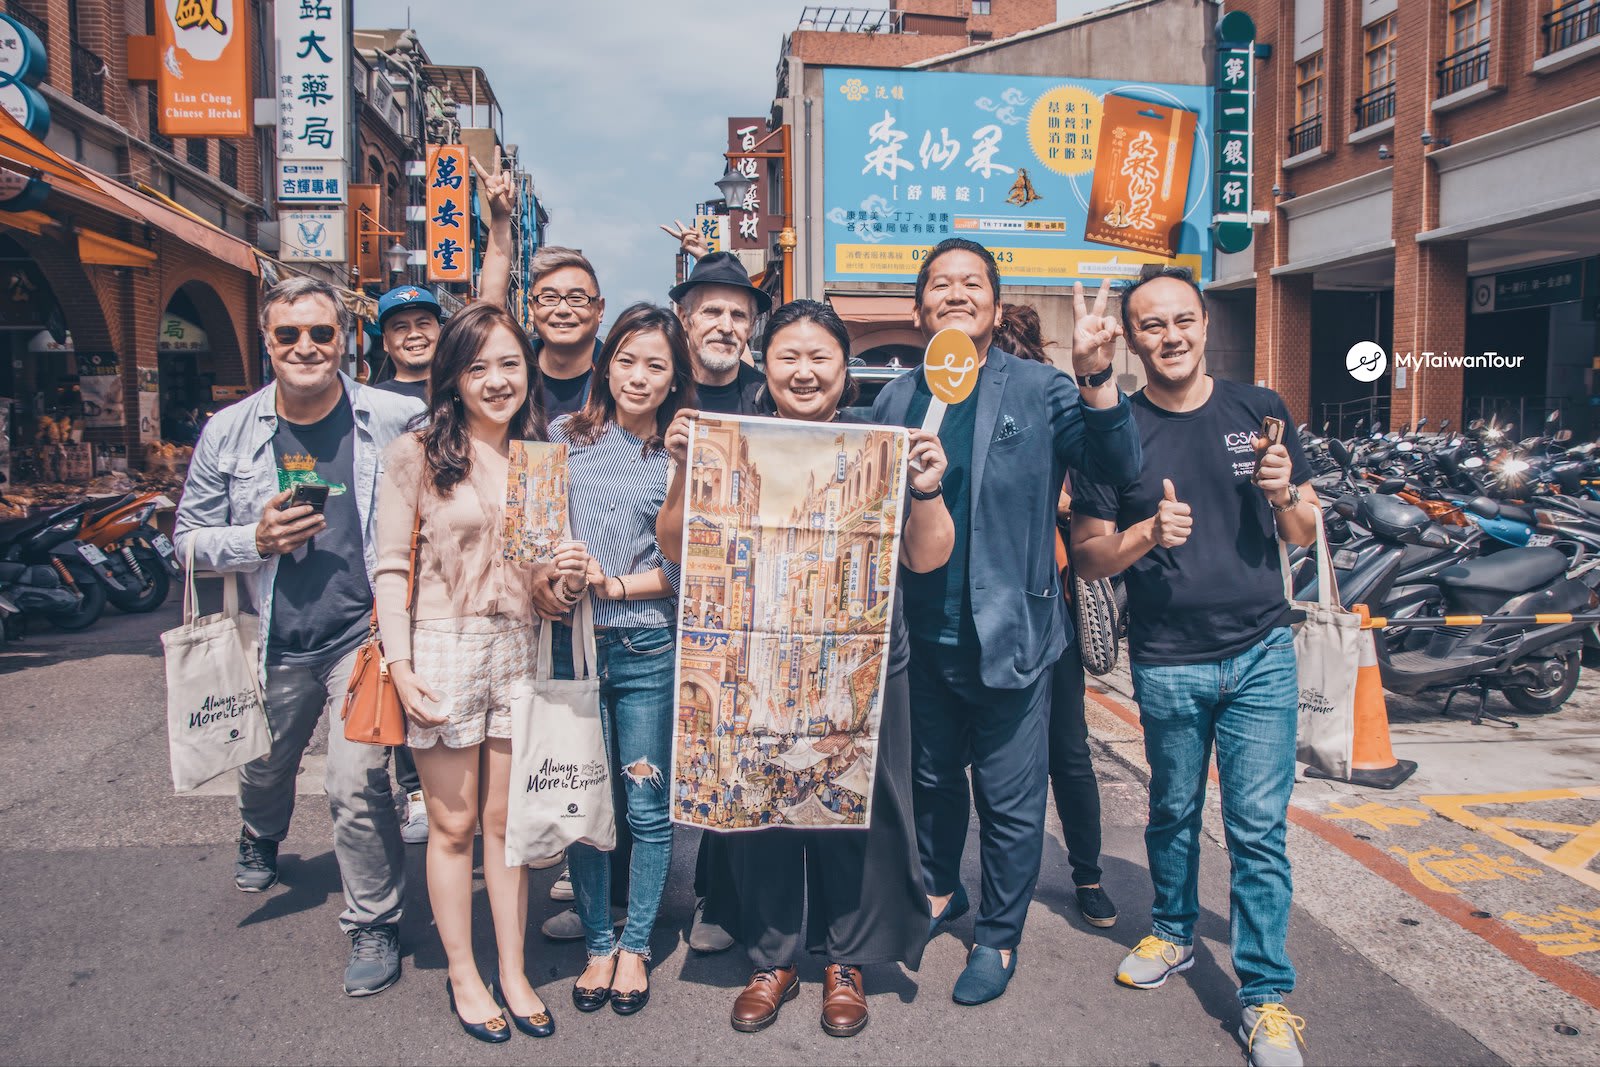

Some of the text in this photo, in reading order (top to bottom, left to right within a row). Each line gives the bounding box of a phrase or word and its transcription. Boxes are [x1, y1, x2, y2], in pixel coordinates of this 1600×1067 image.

[174, 92, 232, 105] Lian Cheng
[165, 108, 242, 119] Chinese Herbal
[281, 75, 294, 153] 健保特約藥局
[1222, 58, 1246, 207] 第一銀行
[283, 178, 339, 195] 杏輝專櫃
[432, 155, 464, 270] 萬安堂
[201, 695, 236, 712] Always
[1297, 702, 1335, 715] xperience
[189, 710, 223, 729] More
[539, 758, 579, 781] Always
[526, 774, 560, 793] More
[561, 779, 569, 789] to
